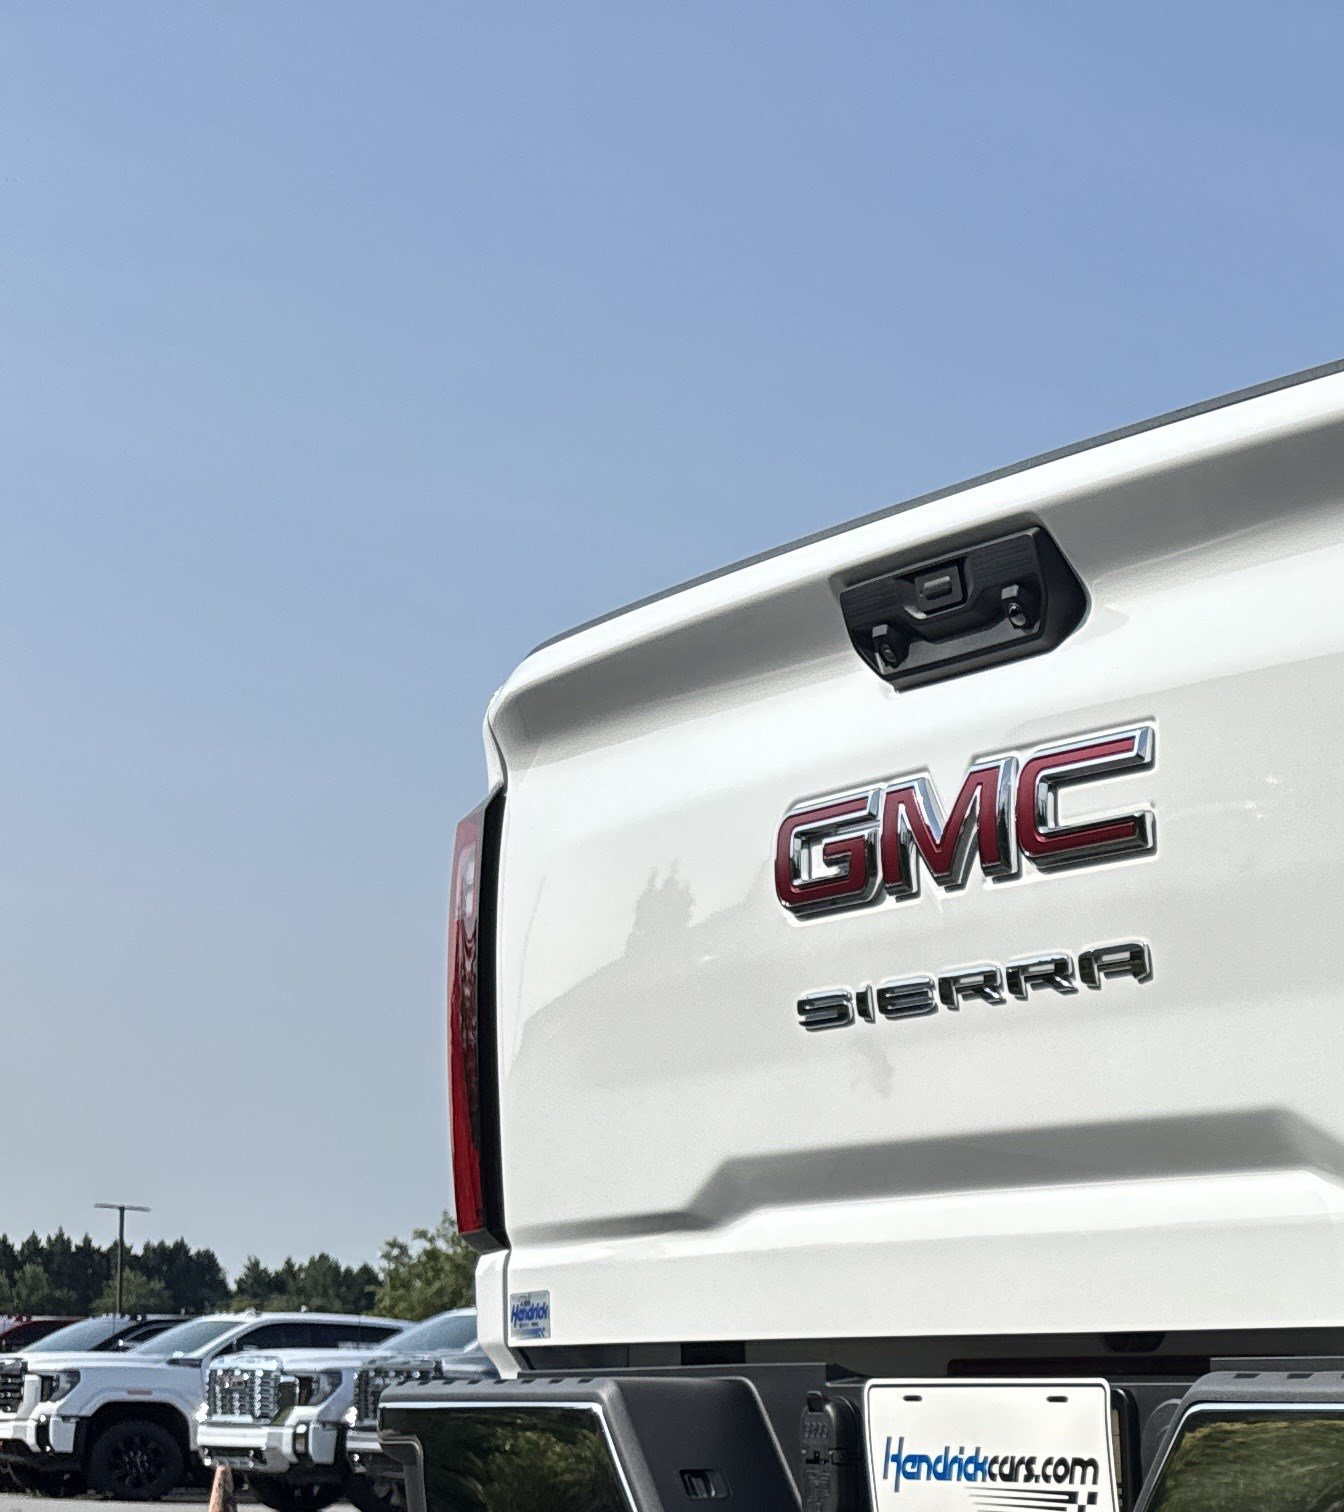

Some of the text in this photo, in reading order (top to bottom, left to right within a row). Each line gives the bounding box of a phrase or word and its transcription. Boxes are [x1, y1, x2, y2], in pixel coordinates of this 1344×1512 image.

[775, 725, 1156, 921] GMC
[796, 938, 1155, 1032] SIERRA
[882, 1436, 1100, 1493] Hendrickcars.com
